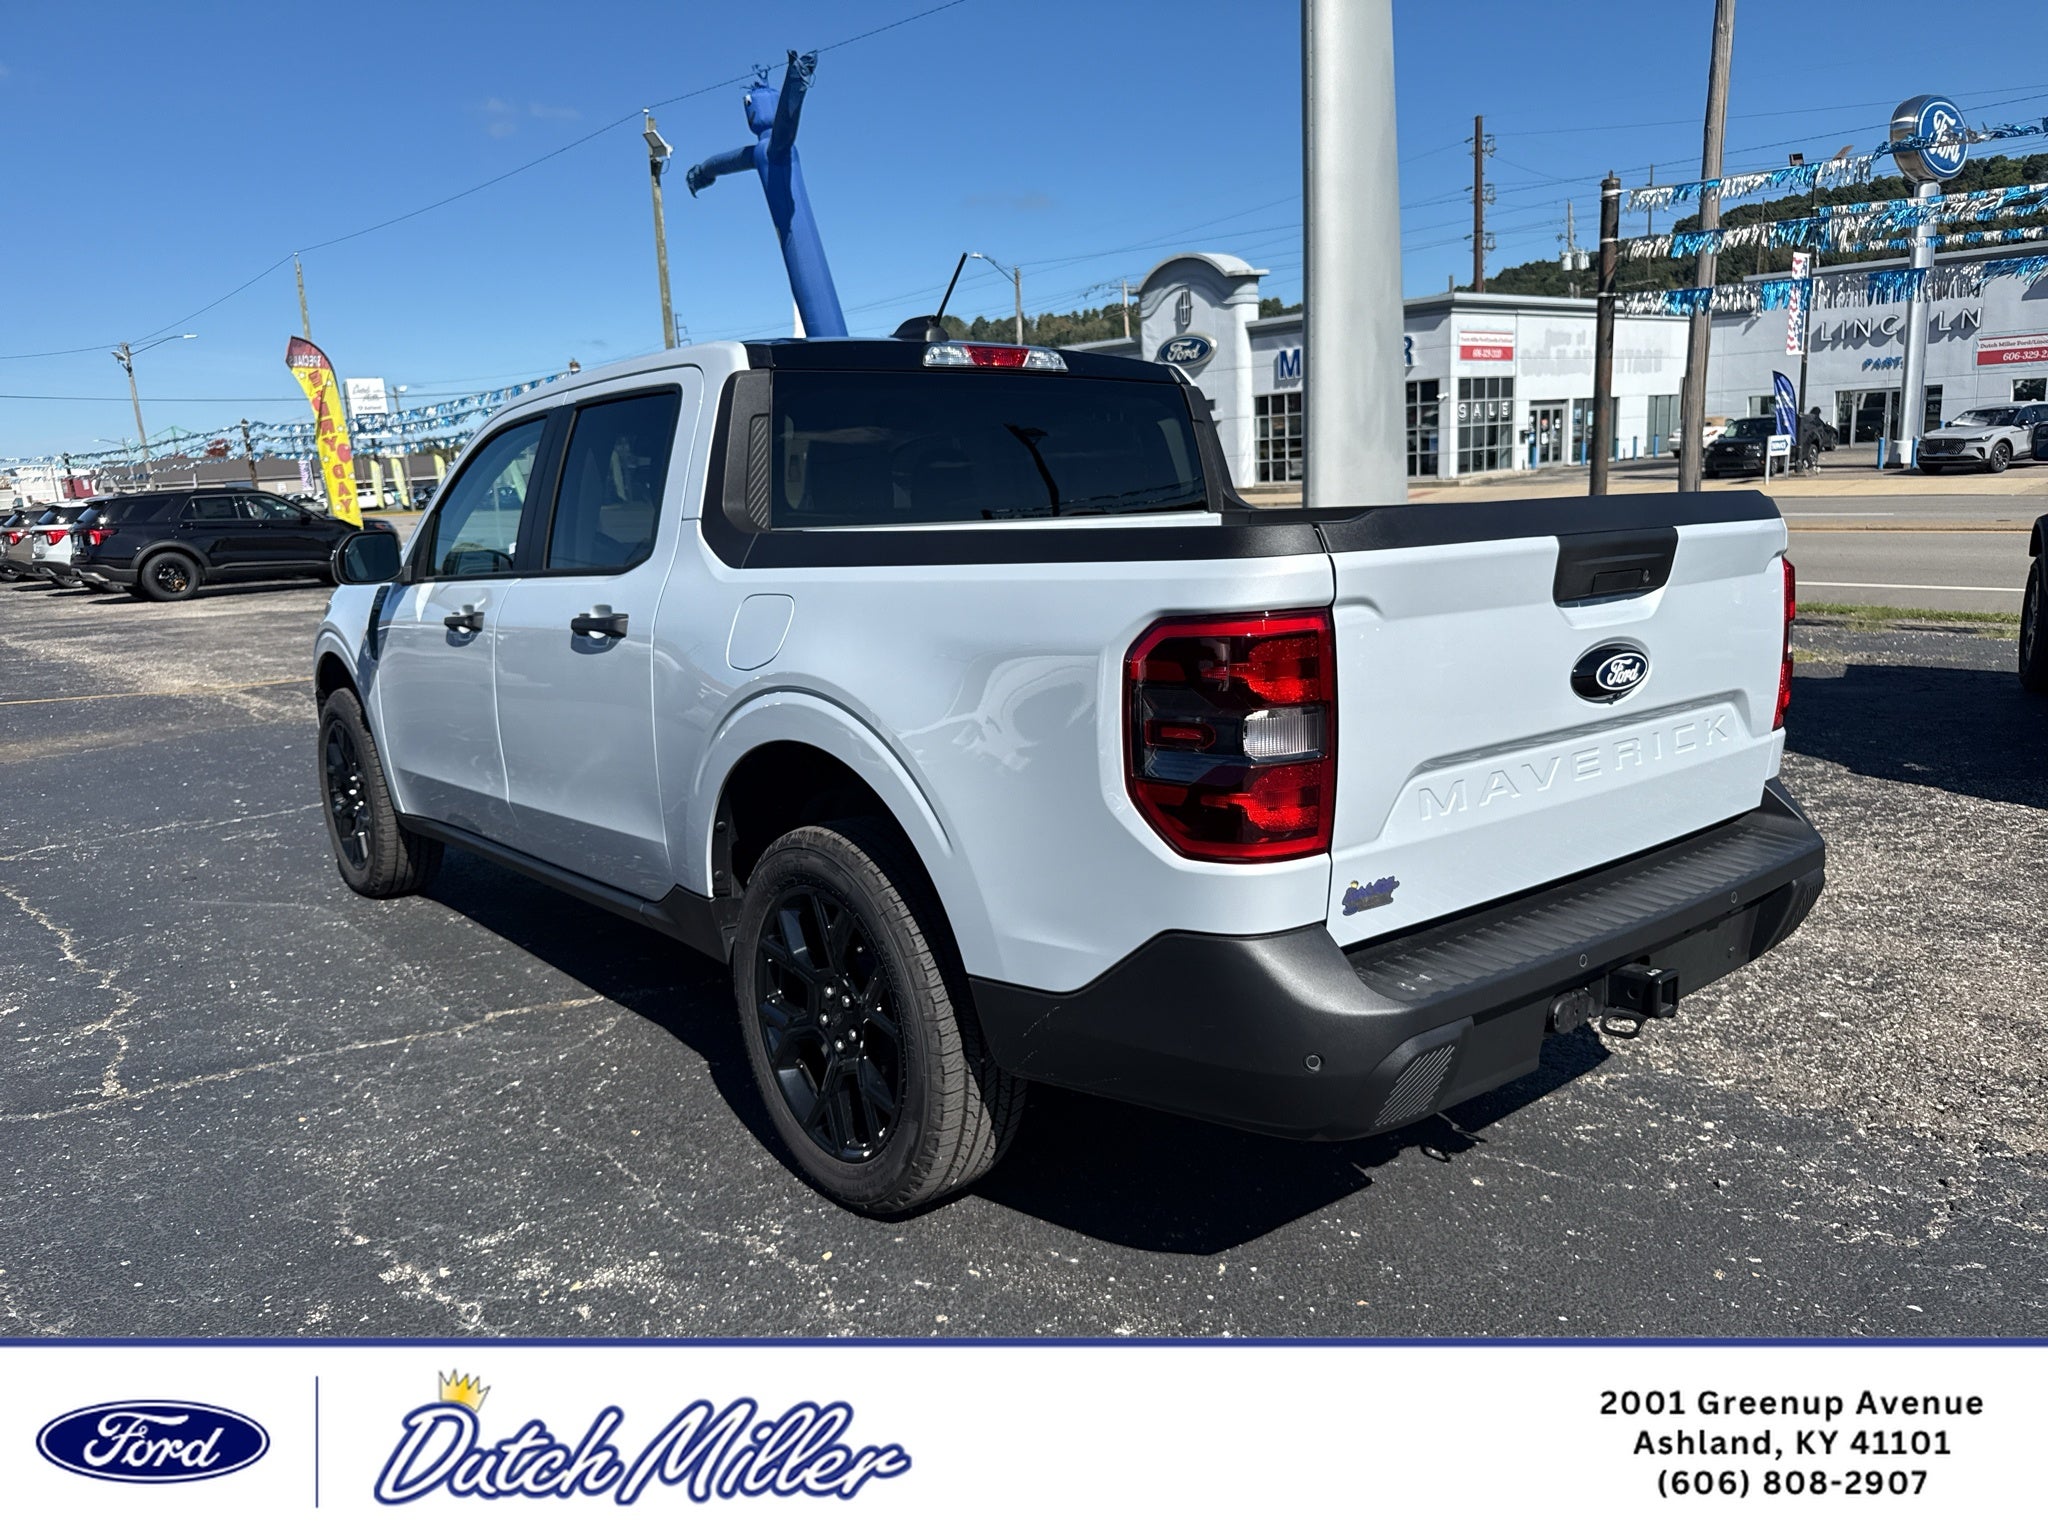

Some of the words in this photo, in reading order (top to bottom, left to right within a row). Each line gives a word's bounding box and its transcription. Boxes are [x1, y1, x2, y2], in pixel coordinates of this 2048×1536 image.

[1928, 110, 1963, 163] Ford
[1820, 307, 1982, 341] LINCLN
[1167, 341, 1201, 361] Ford
[2003, 350, 2048, 361] 606-329-2
[1458, 401, 1509, 420] SALE
[1607, 658, 1640, 685] Ford
[1418, 714, 1730, 821] MAVERICK
